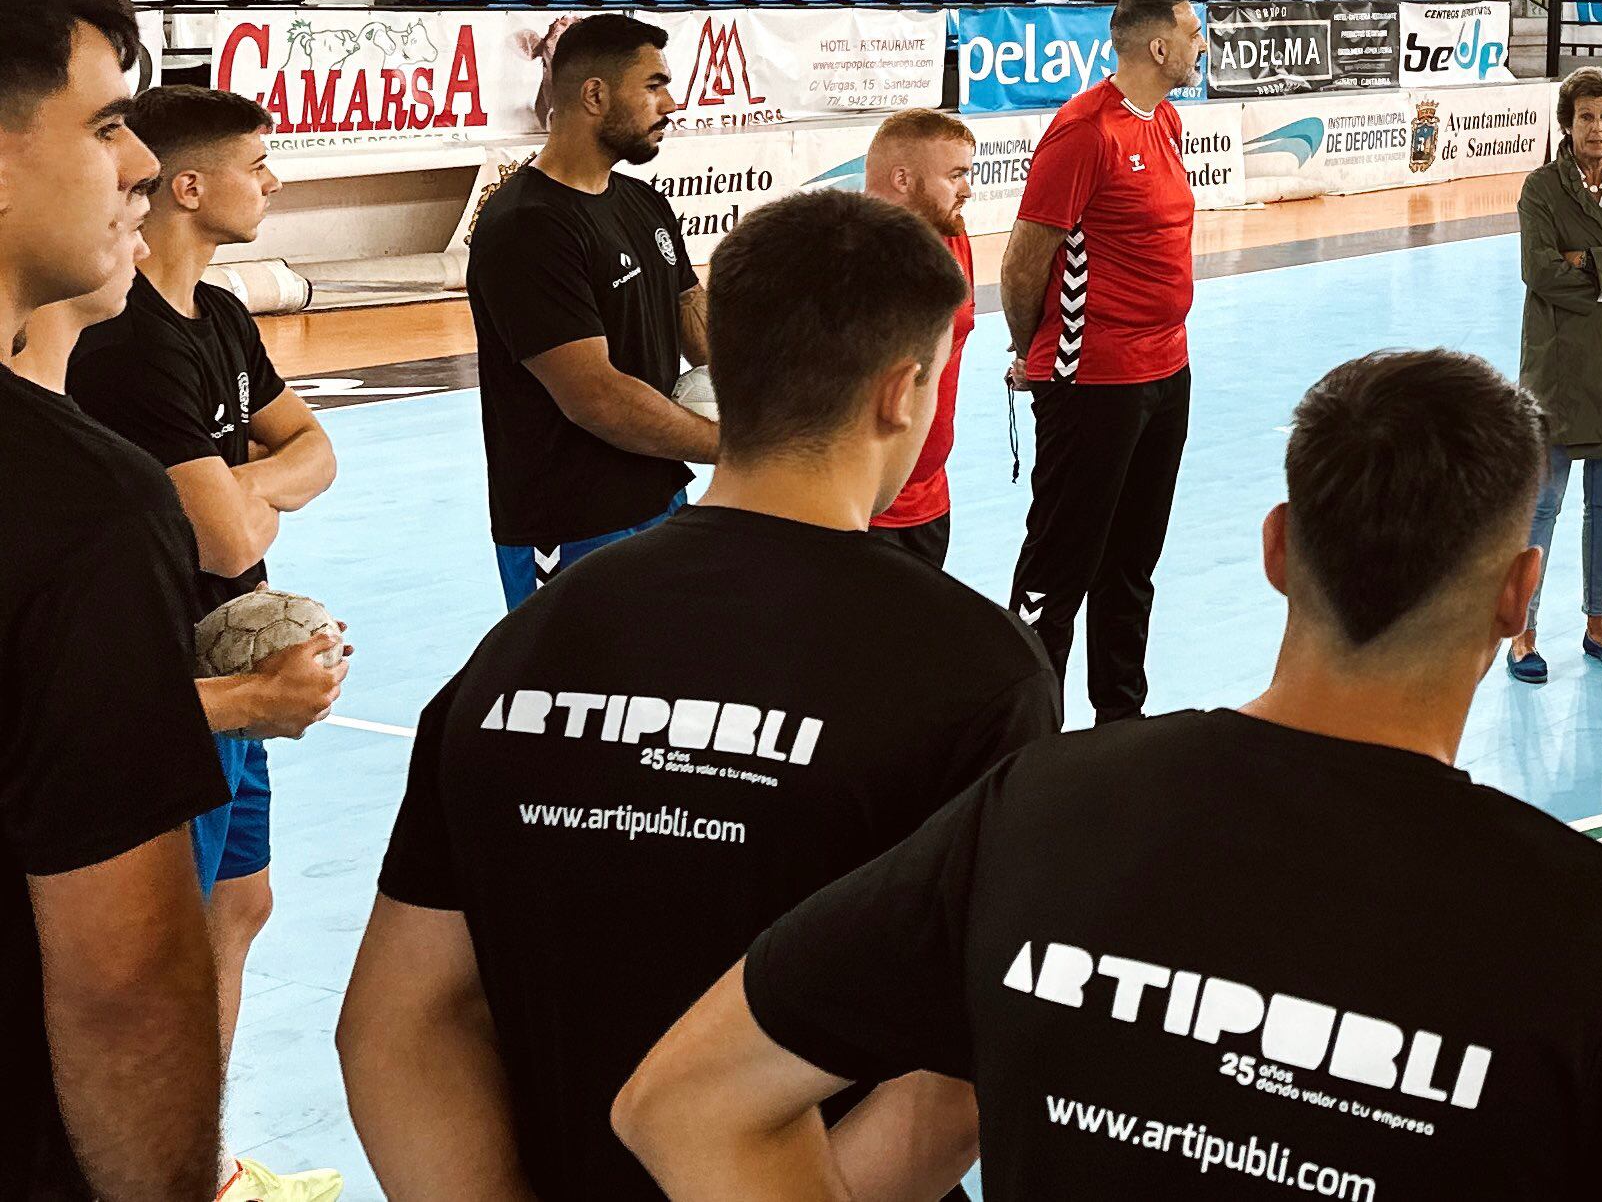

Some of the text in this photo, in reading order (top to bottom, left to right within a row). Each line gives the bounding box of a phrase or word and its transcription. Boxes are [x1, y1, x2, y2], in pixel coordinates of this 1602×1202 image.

[1220, 37, 1321, 70] ADELMA
[217, 22, 488, 134] CAMARSA
[862, 79, 875, 90] 15
[883, 78, 931, 90] Santander
[847, 95, 867, 107] 942
[868, 95, 887, 106] 231
[1327, 112, 1406, 130] INSTITUTO MUNICIPAL
[1445, 107, 1537, 138] Ayuntamiento
[979, 139, 1035, 156] MUNICIPAL
[1326, 128, 1407, 154] DE DEPORTES
[1441, 134, 1536, 160] de Santander
[649, 166, 773, 198] tamiento
[970, 158, 1032, 186] PORTES
[480, 689, 824, 766] ARTIPUBLI
[640, 747, 665, 770] 25
[519, 803, 746, 844] www.artipubli.com
[1003, 940, 1492, 1110] ARTIPUBLI
[1219, 1052, 1293, 1086] 25 años
[1256, 1077, 1435, 1136] dando valor a tu empresa
[1046, 1094, 1376, 1202] www.artipubli.com
